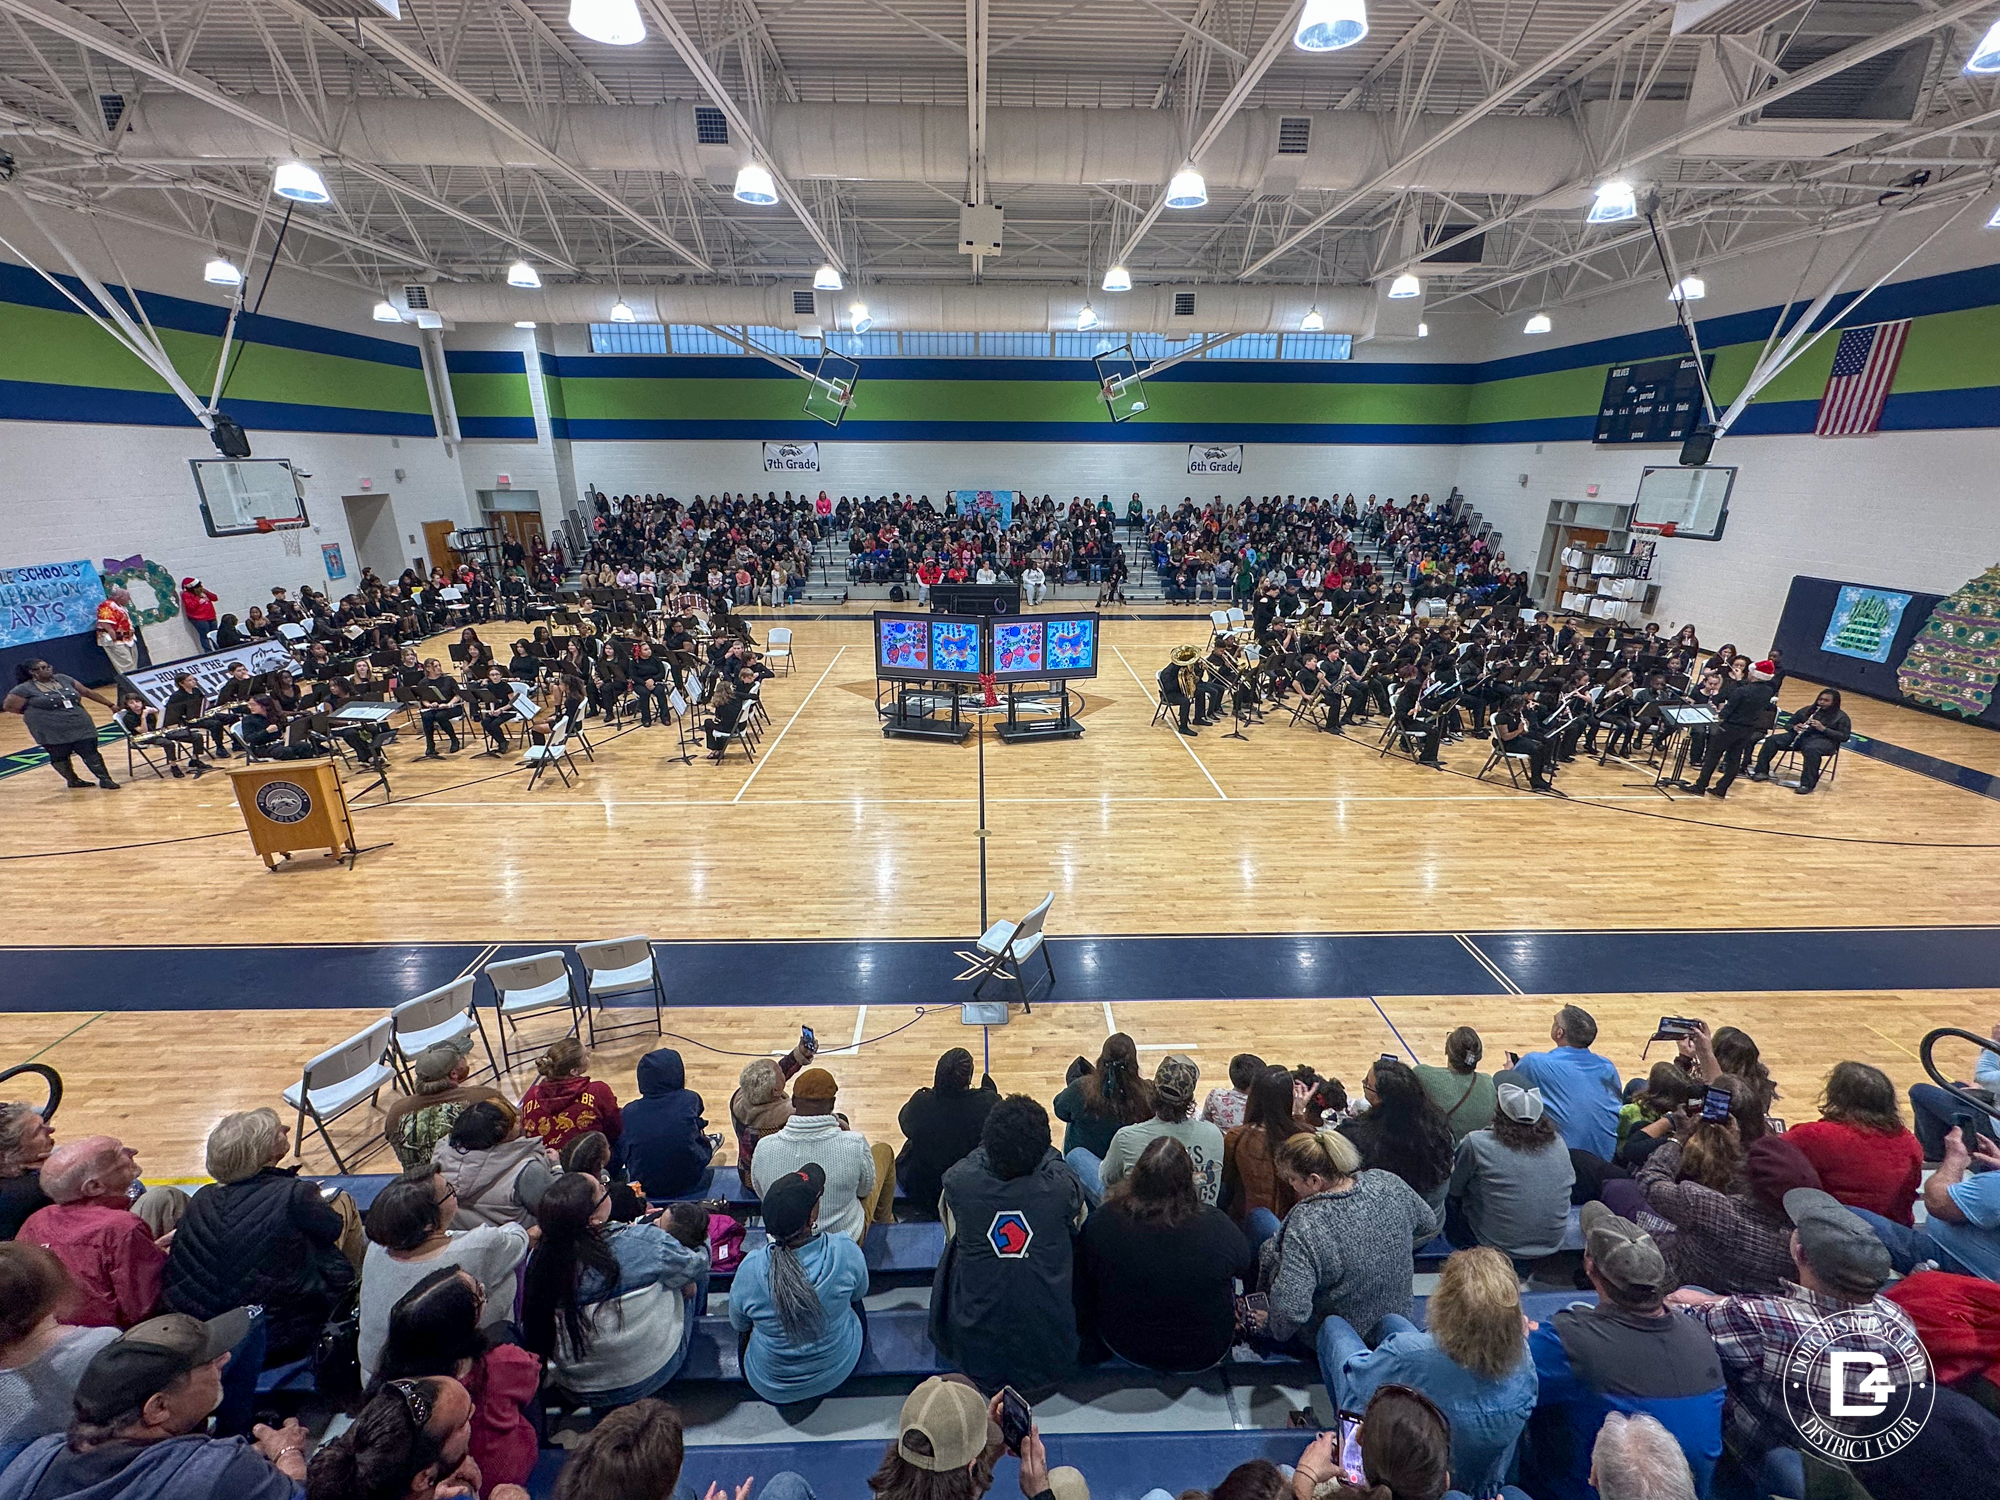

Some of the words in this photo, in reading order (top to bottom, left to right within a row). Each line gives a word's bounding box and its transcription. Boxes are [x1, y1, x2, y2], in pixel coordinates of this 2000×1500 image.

[1613, 368, 1630, 377] WOLVES
[1639, 391, 1655, 401] period
[1635, 405, 1652, 415] player
[1676, 403, 1689, 411] fouls
[1631, 432, 1644, 440] game
[767, 458, 783, 469] 7th
[786, 458, 816, 469] Grade
[1190, 461, 1206, 471] 6th
[1209, 461, 1239, 471] Grade
[18, 563, 81, 582] SCHOOL'S
[11, 601, 66, 629] ARTS
[186, 664, 201, 675] OF
[201, 658, 225, 671] THE
[581, 1092, 595, 1108] BE
